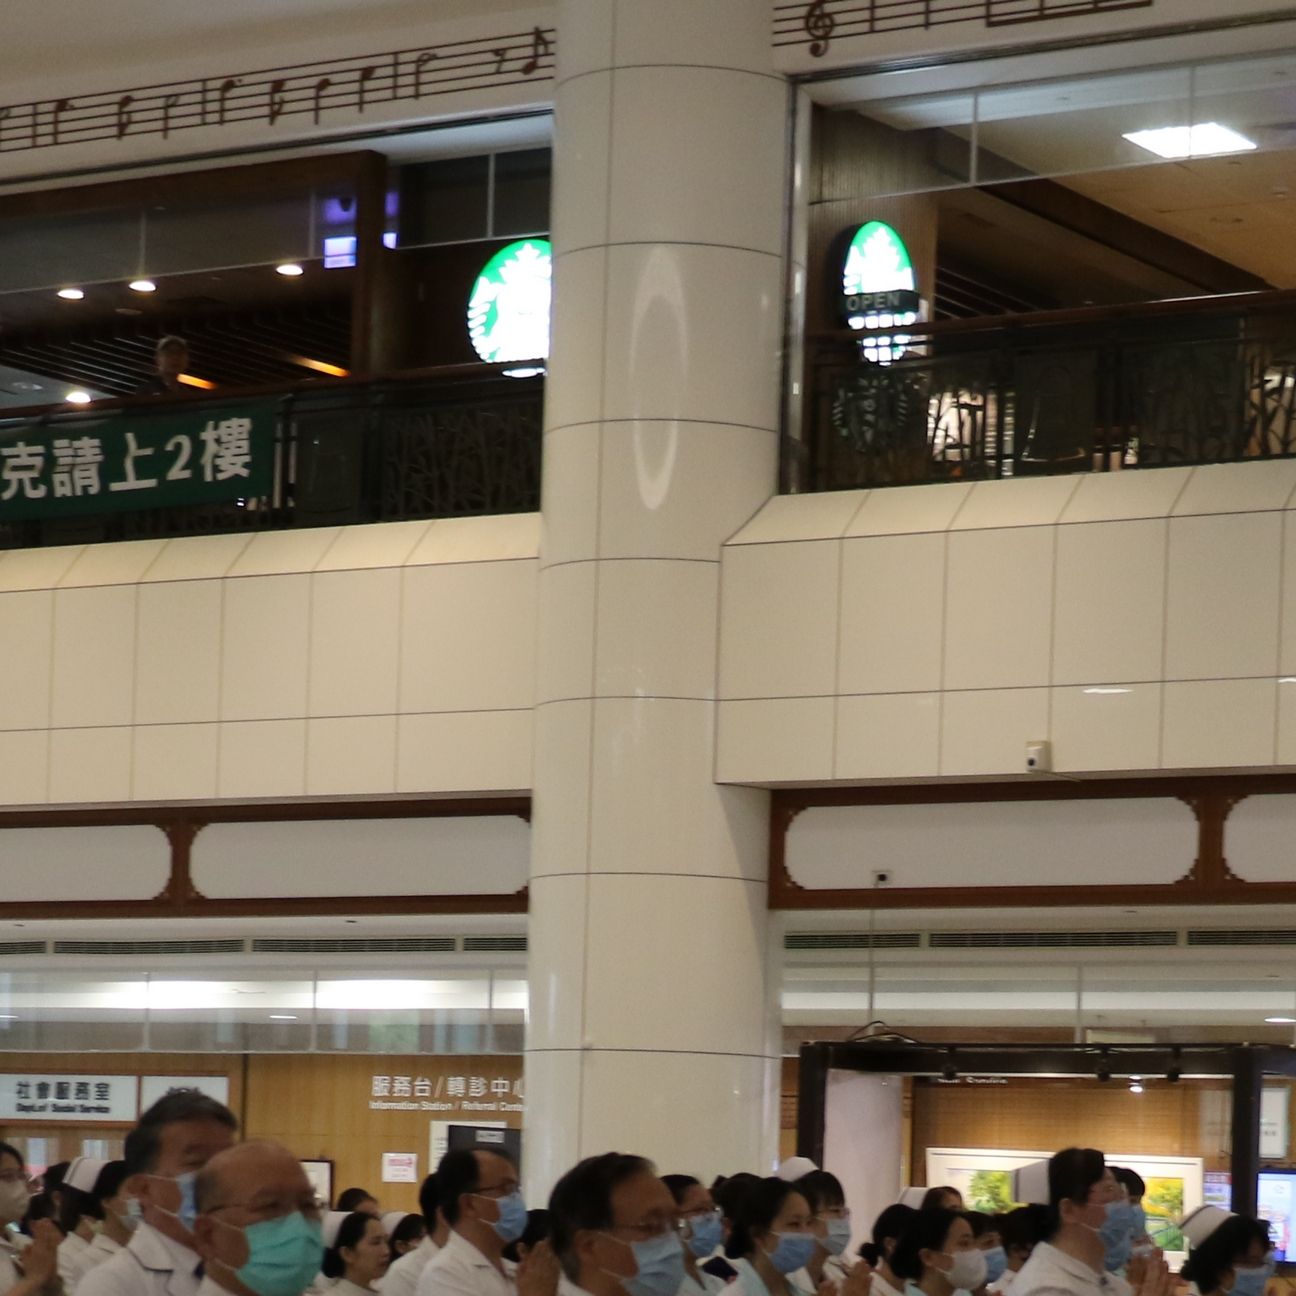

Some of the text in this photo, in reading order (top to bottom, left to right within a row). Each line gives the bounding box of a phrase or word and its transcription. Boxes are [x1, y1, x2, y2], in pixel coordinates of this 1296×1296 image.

[846, 292, 901, 311] OPEN
[16, 1081, 110, 1100] 社會服務室
[421, 1101, 452, 1111] Station
